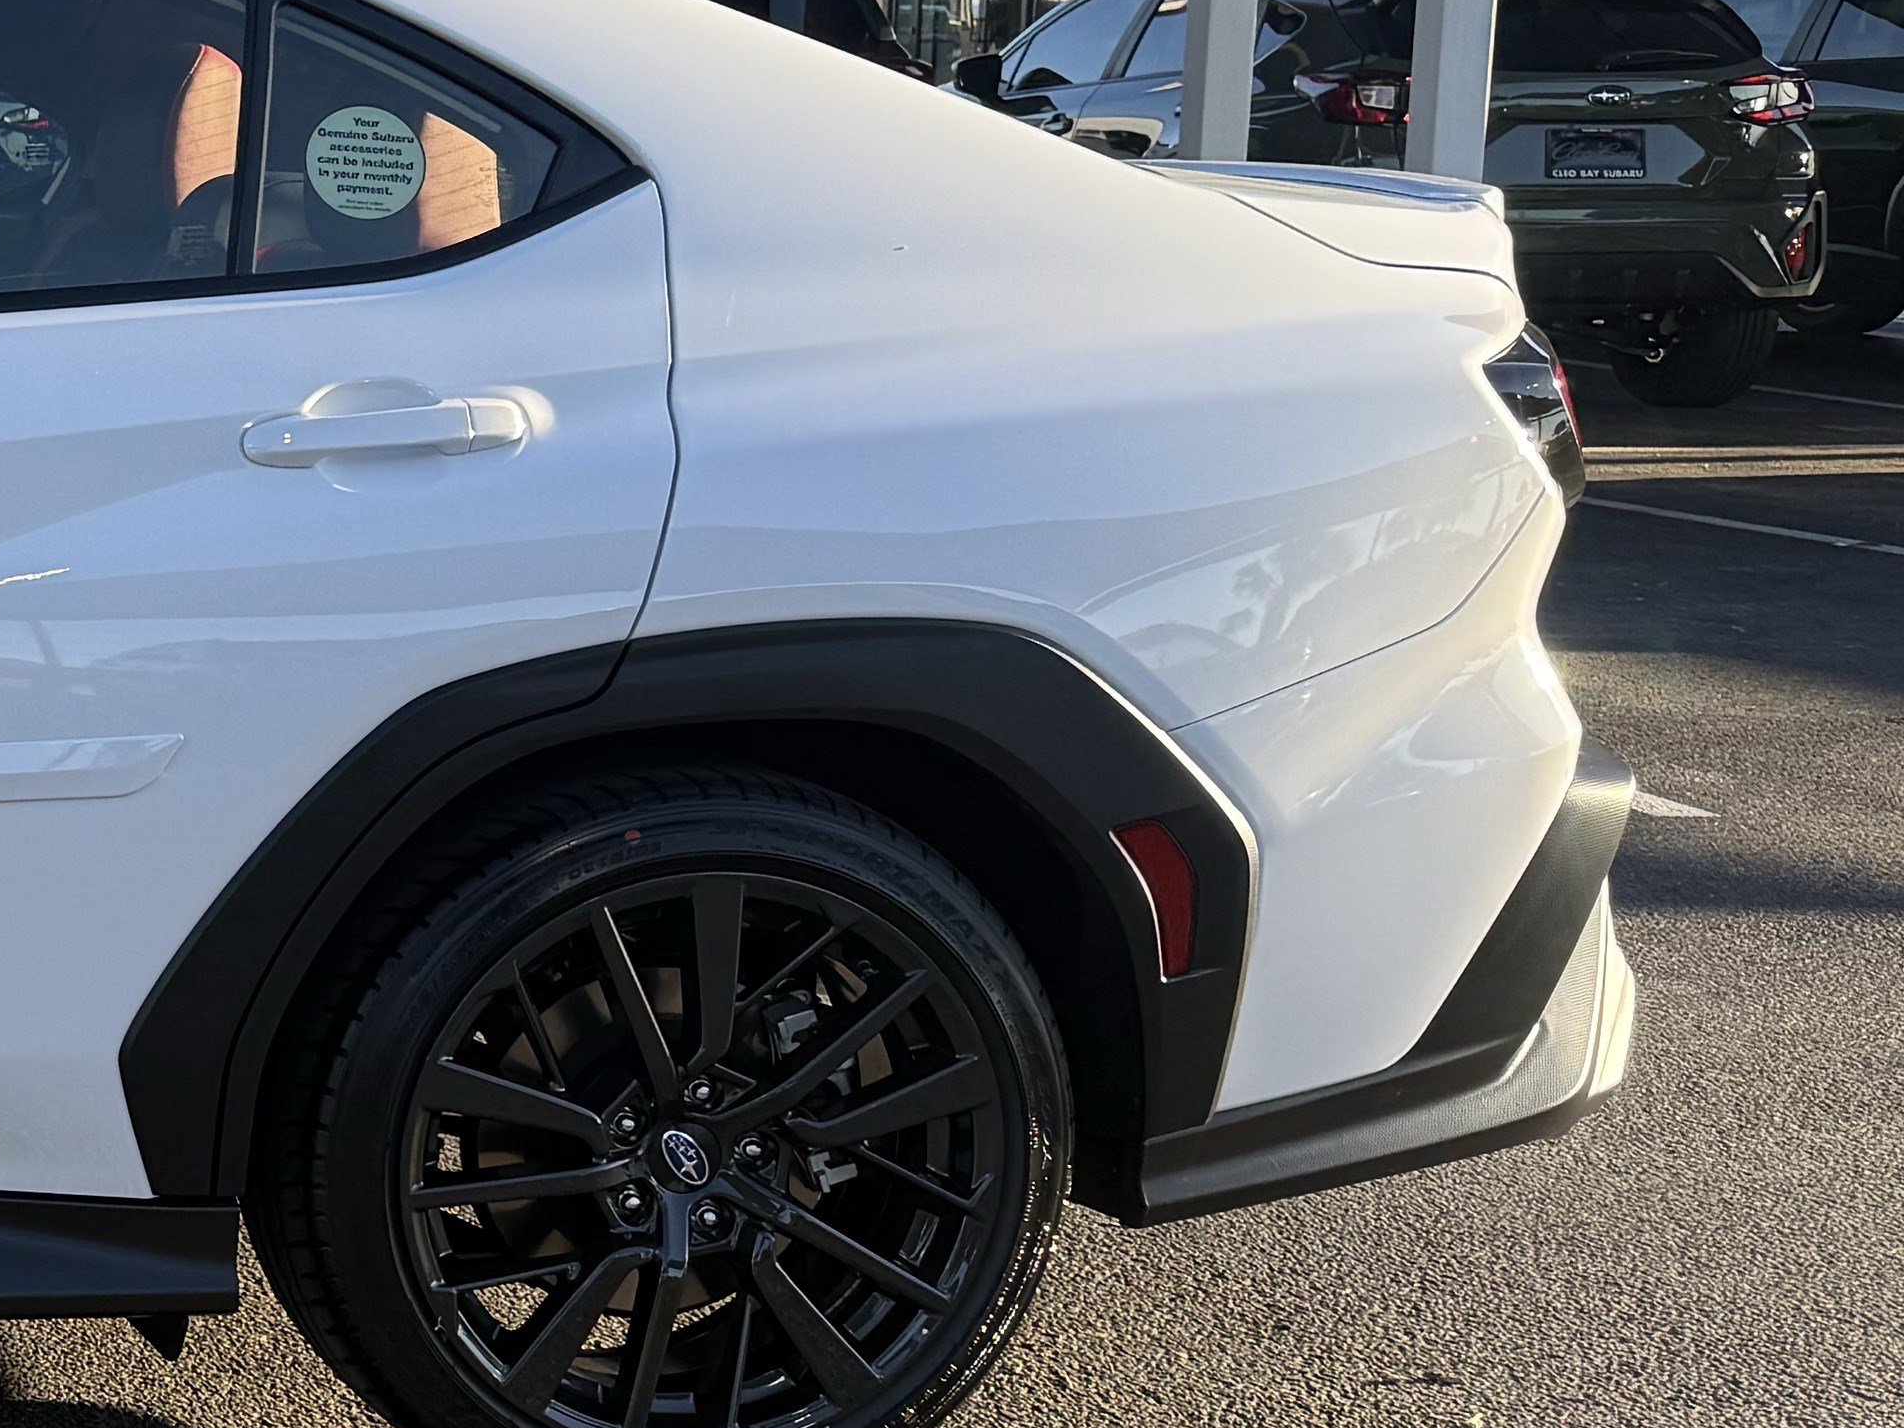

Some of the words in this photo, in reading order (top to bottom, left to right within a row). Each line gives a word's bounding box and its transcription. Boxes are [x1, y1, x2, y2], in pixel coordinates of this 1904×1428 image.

[353, 117, 380, 127] Your
[317, 128, 368, 140] Genuine
[372, 132, 414, 143] Subaru
[330, 144, 402, 156] accessories
[317, 156, 339, 165] can
[343, 156, 358, 166] be
[361, 158, 414, 170] included
[318, 168, 329, 176] in
[333, 170, 359, 179] your
[364, 173, 412, 185] monthly
[1552, 169, 1577, 178] CLEO
[1579, 169, 1600, 178] BAY
[1603, 169, 1644, 178] SUBARU
[337, 184, 393, 196] payment.
